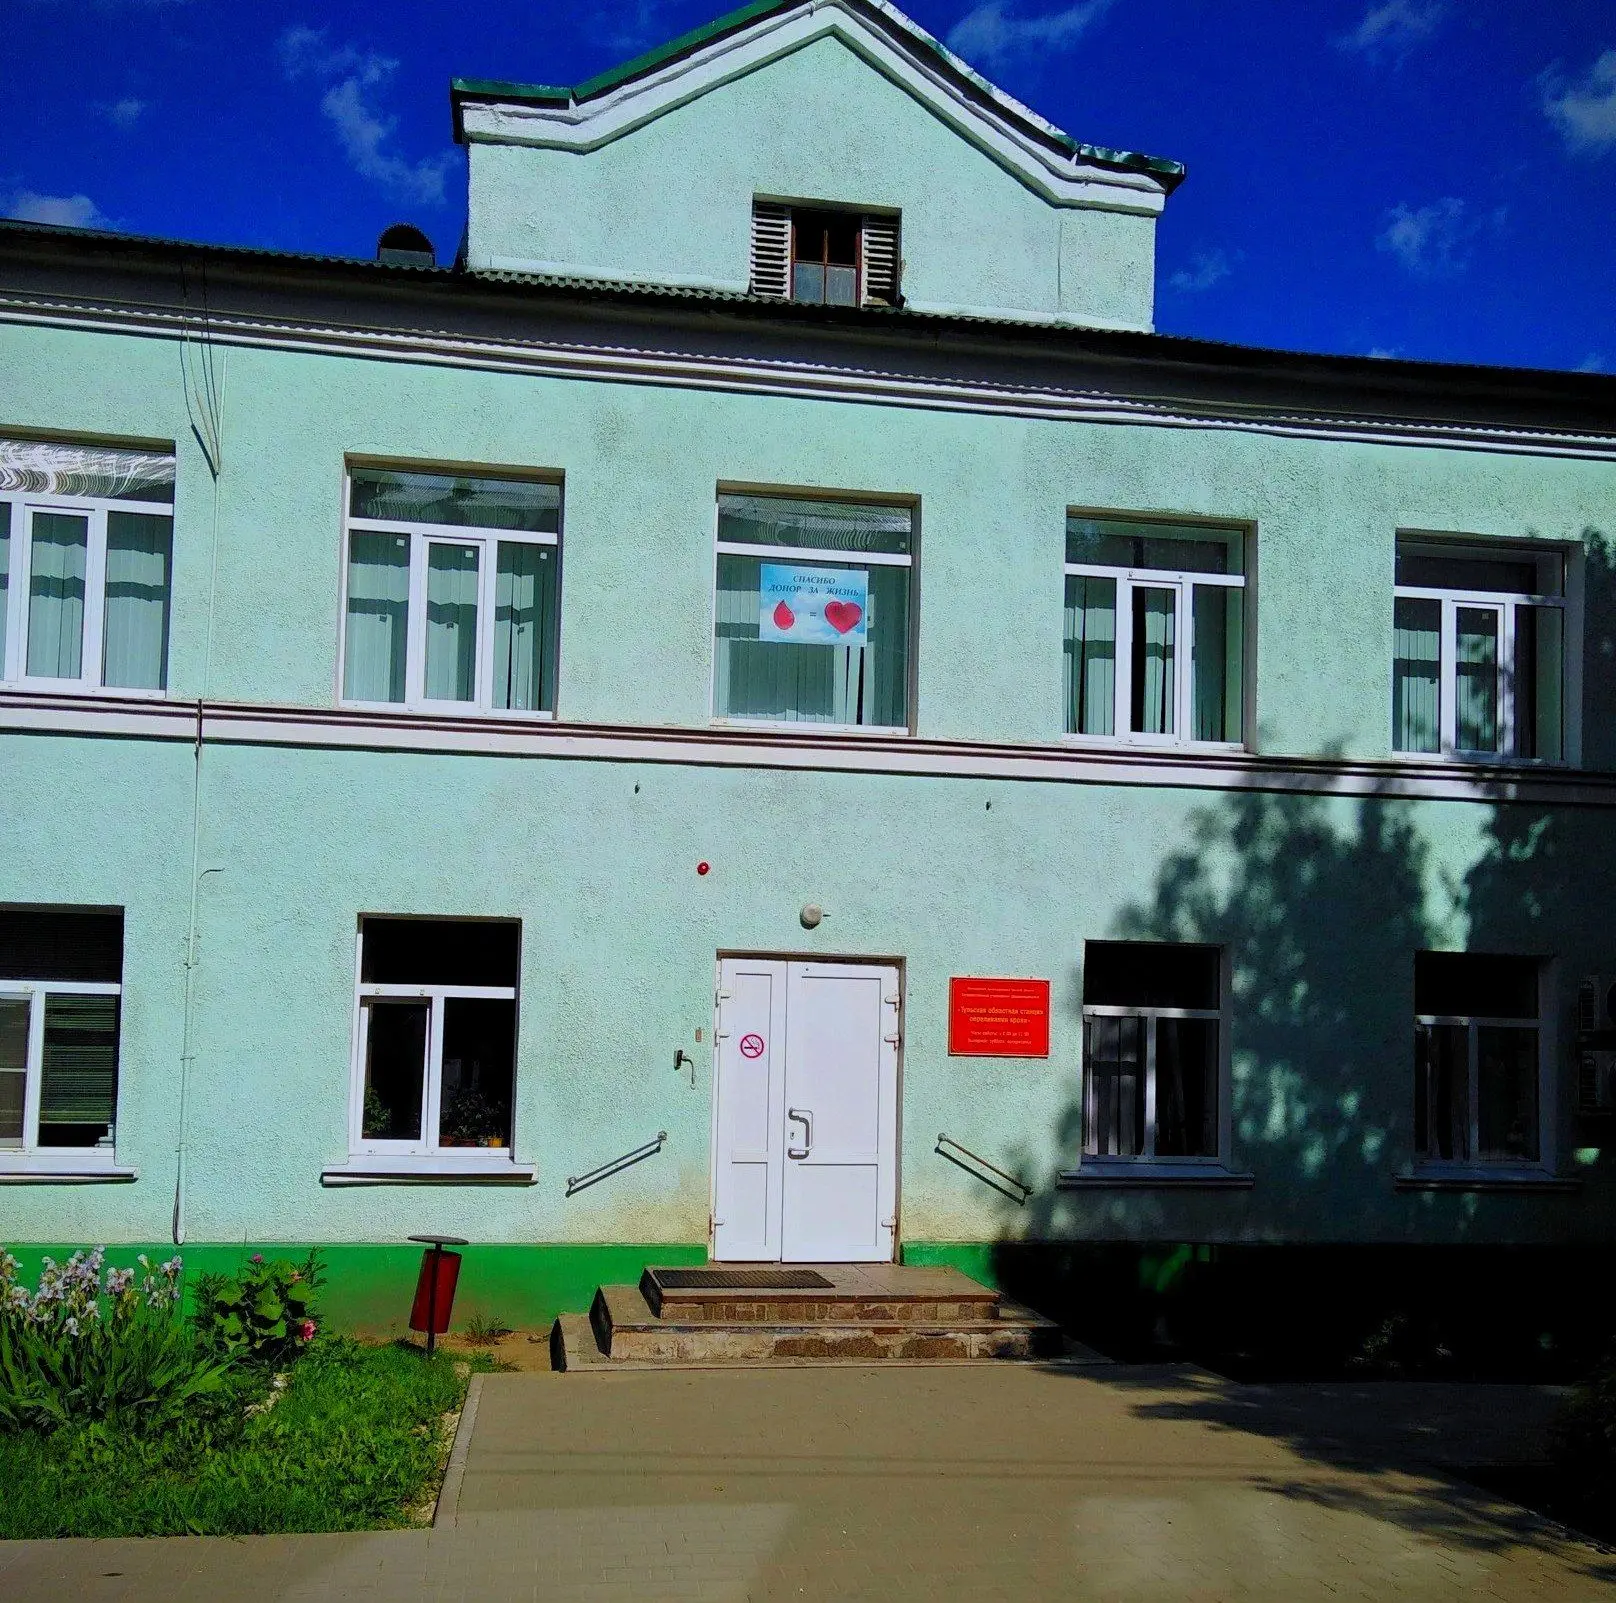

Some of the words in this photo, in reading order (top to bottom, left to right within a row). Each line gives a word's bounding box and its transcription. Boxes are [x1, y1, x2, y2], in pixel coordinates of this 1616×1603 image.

[793, 575, 836, 585] СПАСИБО
[768, 584, 802, 593] ДОНОР
[808, 586, 819, 594] ЗА
[825, 588, 859, 597] ЖИЗНЬ
